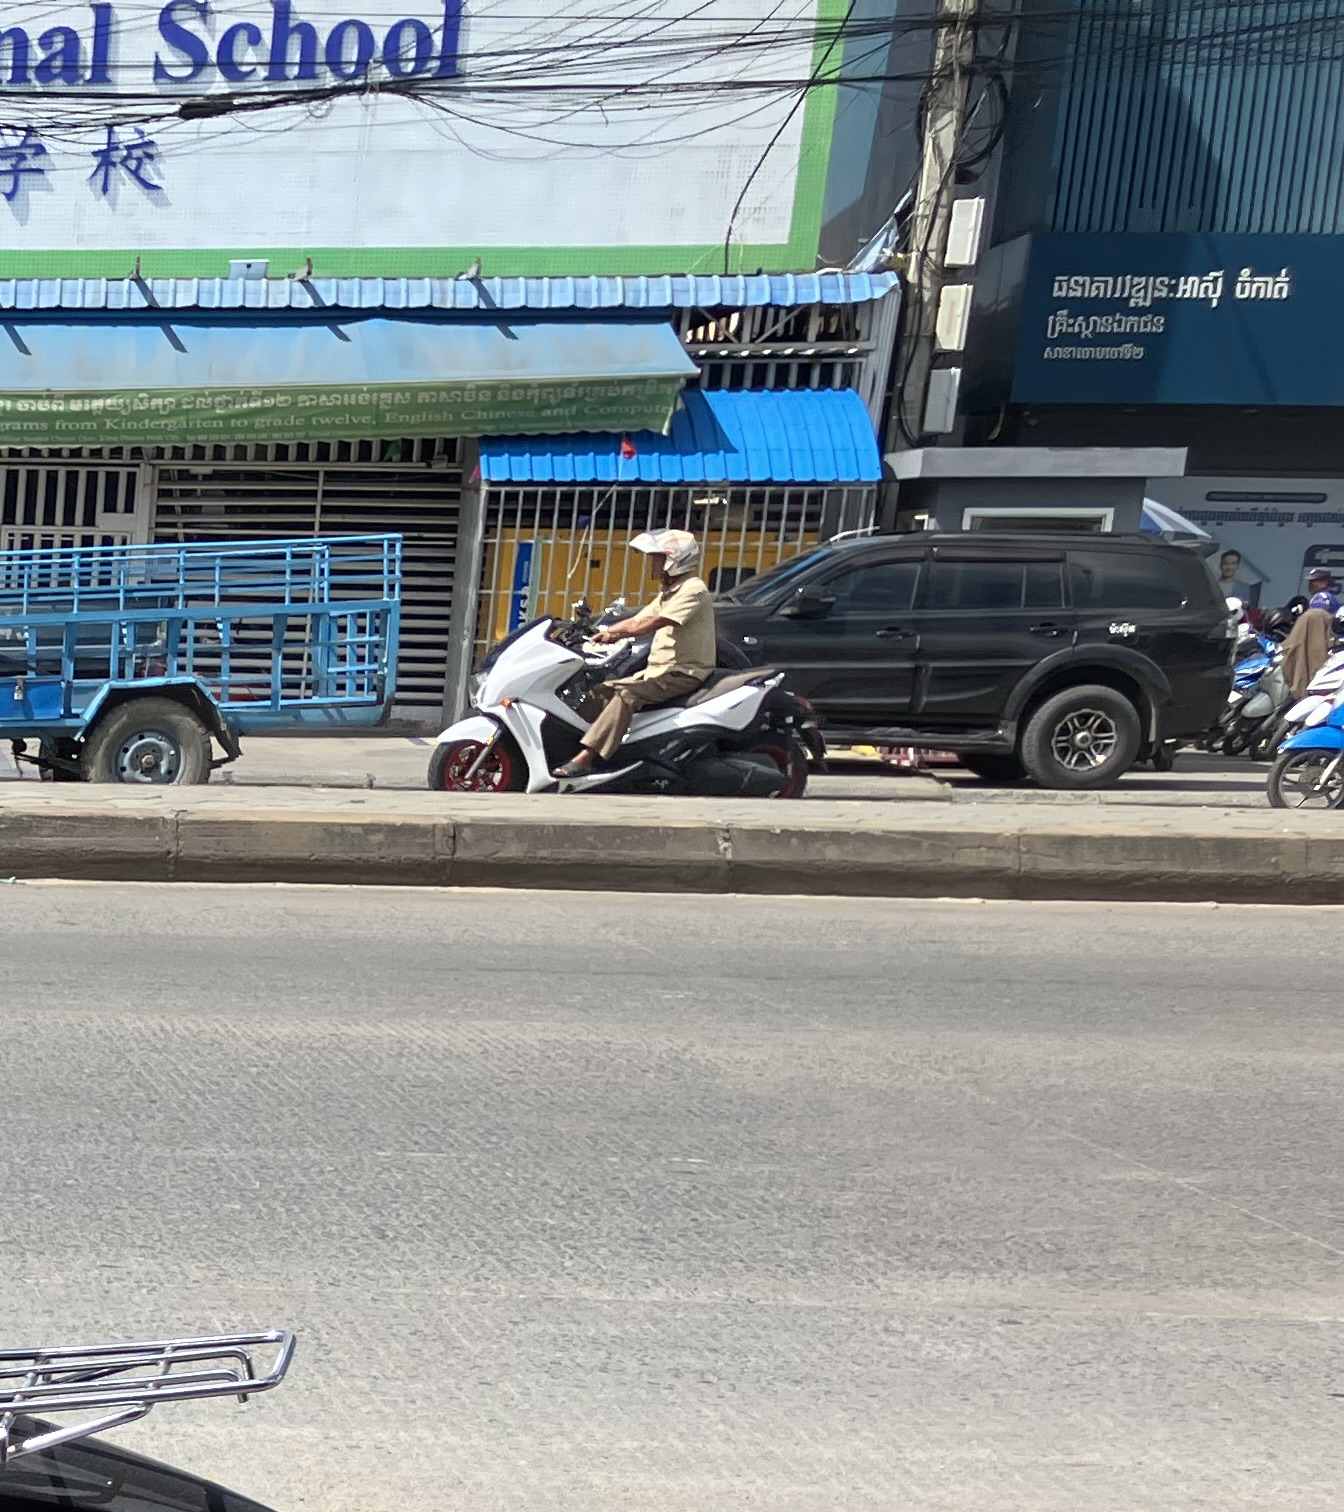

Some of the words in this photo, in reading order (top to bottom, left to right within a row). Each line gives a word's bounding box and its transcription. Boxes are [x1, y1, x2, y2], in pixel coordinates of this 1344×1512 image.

[154, 0, 464, 82] School
[55, 418, 98, 431] from
[104, 416, 224, 432] Kindergarten
[231, 417, 249, 429] to
[254, 414, 306, 430] grade
[383, 410, 454, 425] English
[460, 406, 527, 422] Chinese
[540, 403, 577, 418] and
